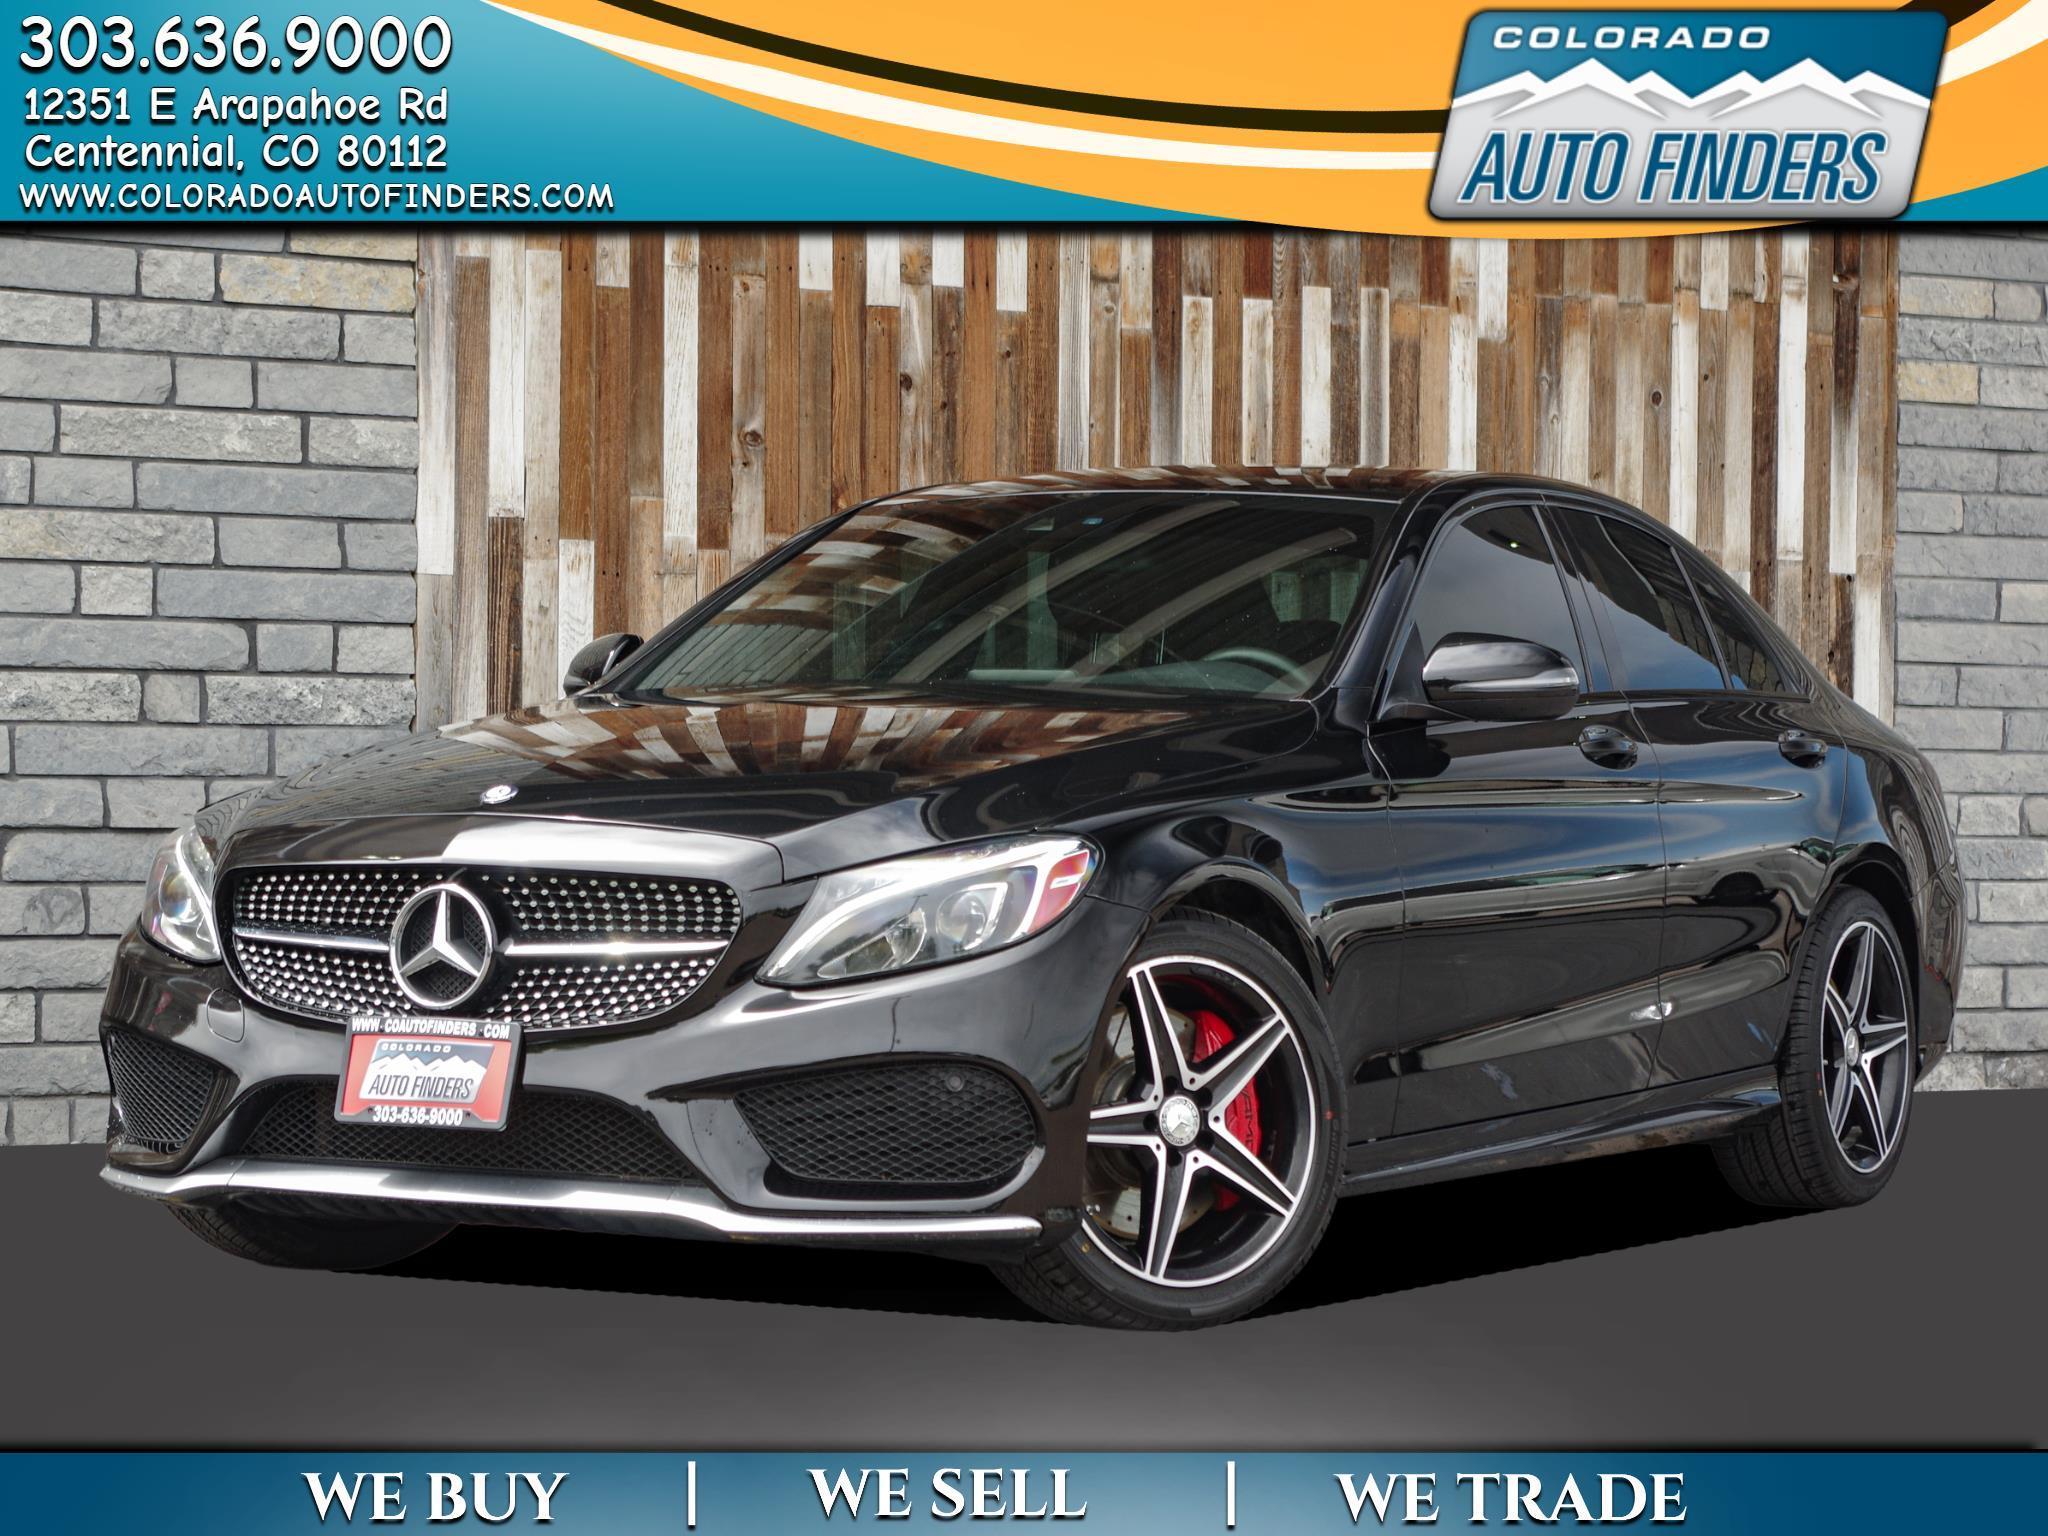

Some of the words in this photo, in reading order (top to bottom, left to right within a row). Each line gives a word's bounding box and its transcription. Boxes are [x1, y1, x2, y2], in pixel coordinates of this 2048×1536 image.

[381, 1043, 451, 1052] COLORADO
[369, 1075, 409, 1095] AUTO
[412, 1076, 474, 1099] FINDERS
[373, 1106, 463, 1126] 303-636-9000
